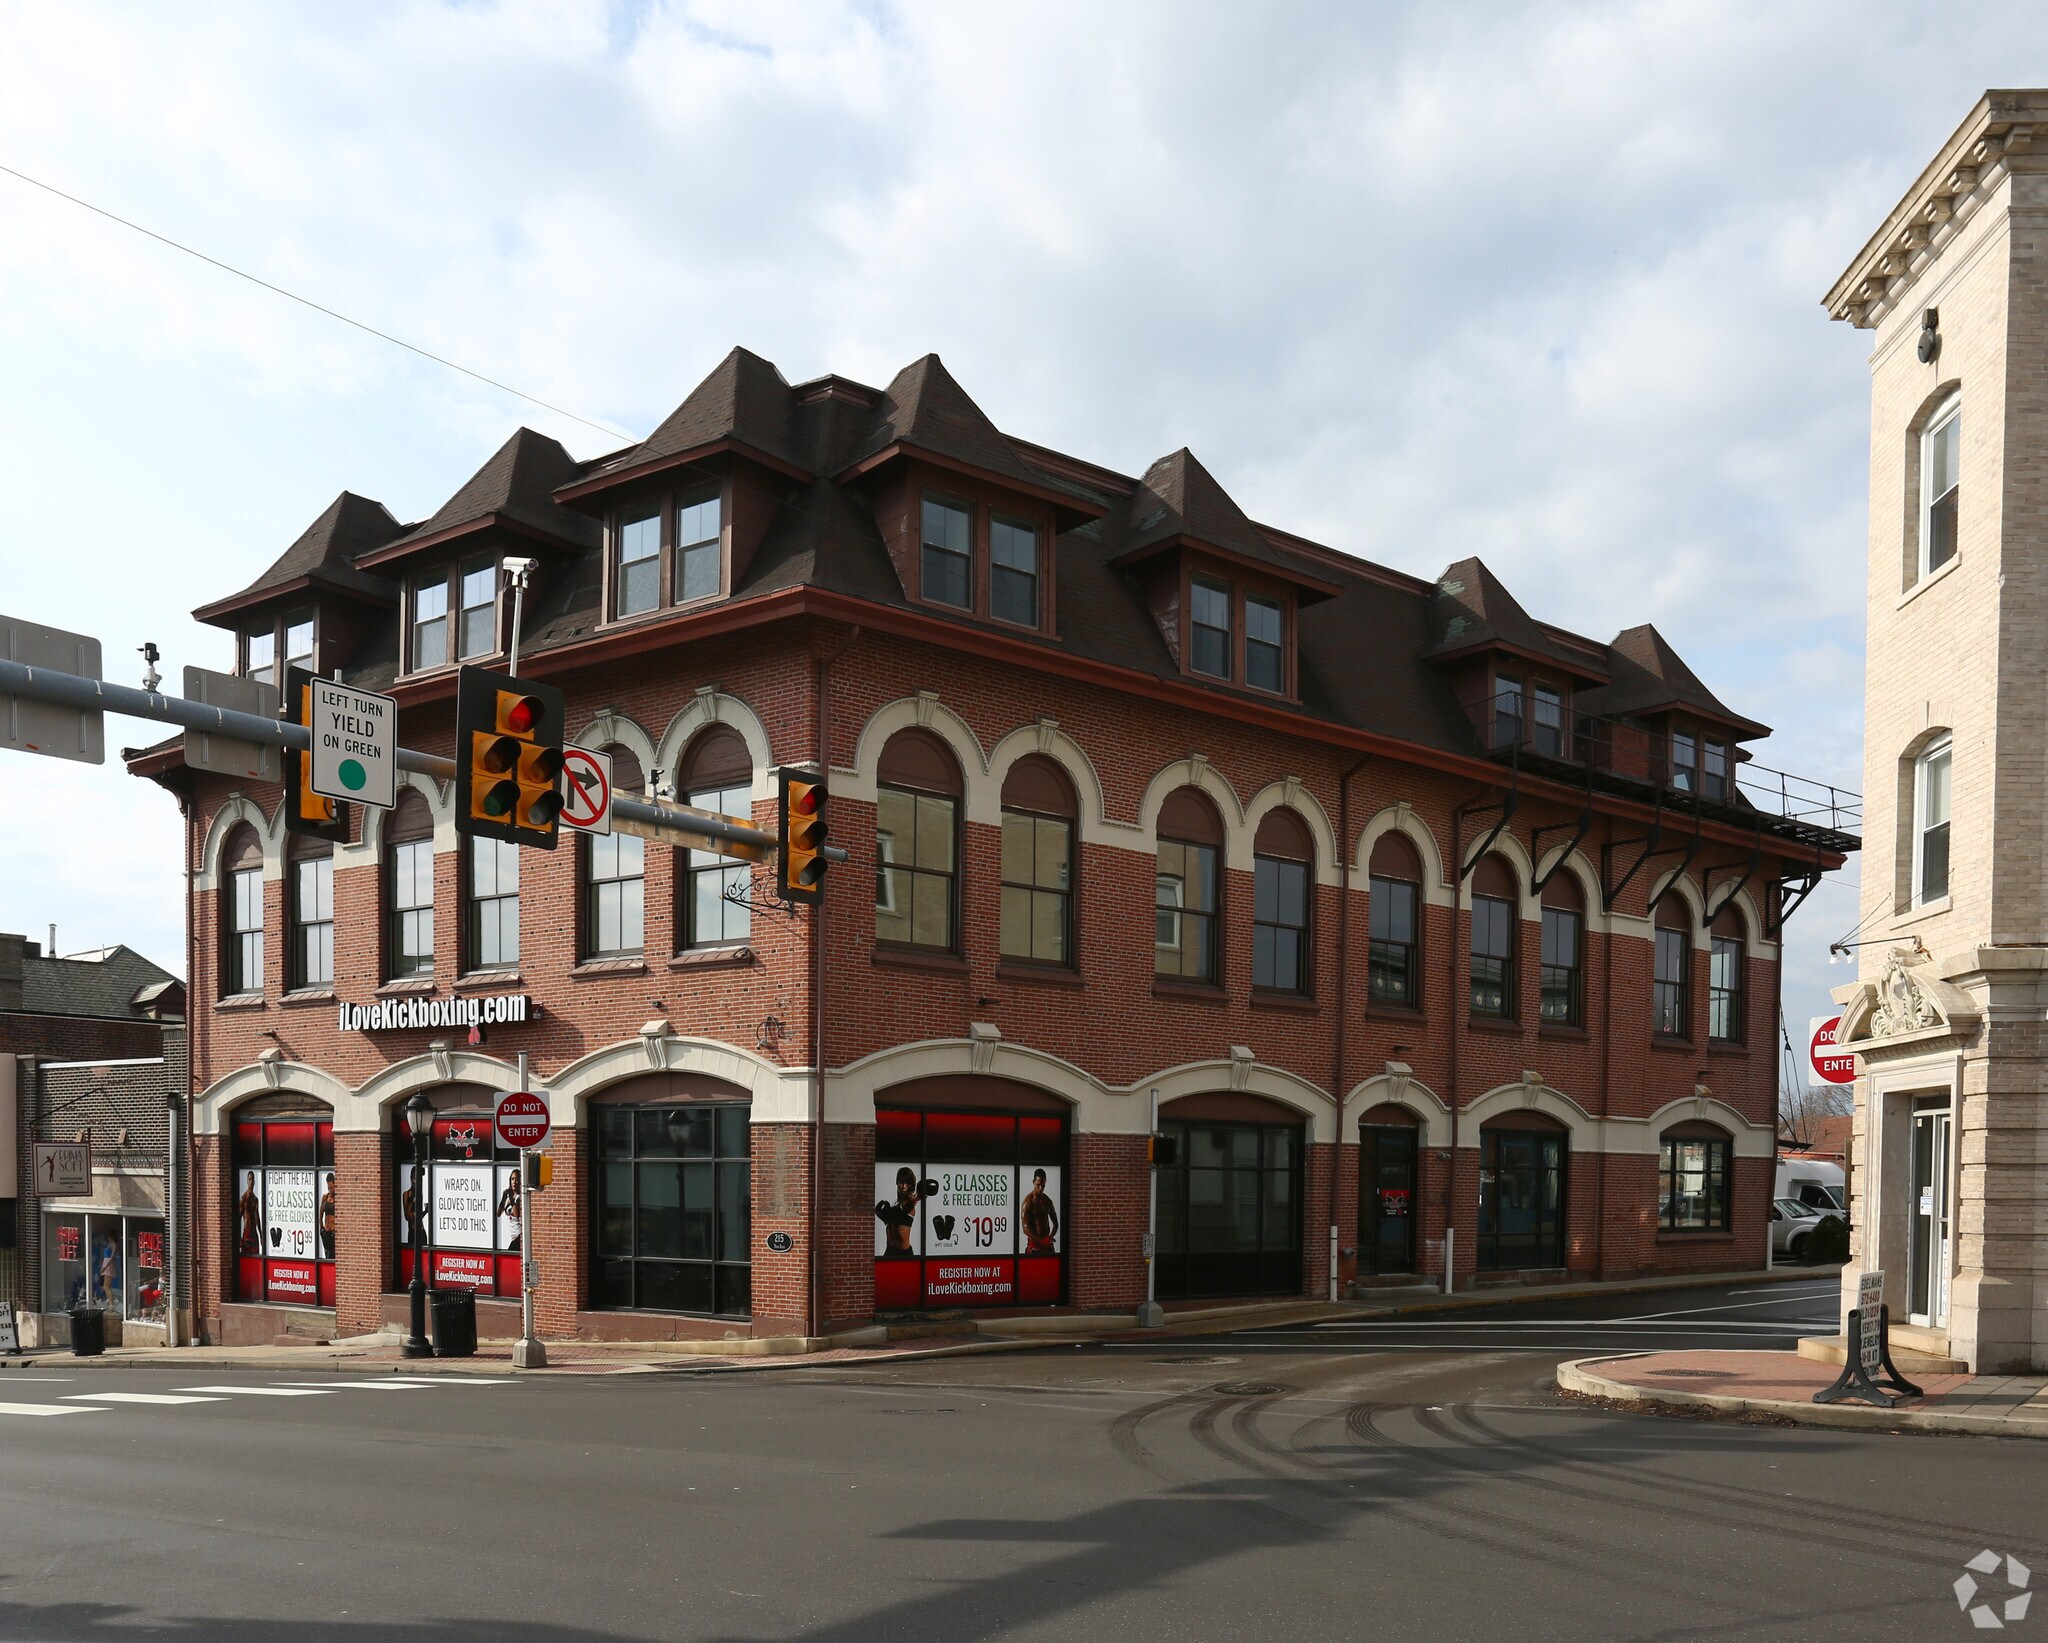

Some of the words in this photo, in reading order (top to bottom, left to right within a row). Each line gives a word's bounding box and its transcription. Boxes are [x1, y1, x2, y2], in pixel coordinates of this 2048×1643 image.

[322, 690, 349, 708] LEFT
[354, 698, 383, 717] TURN
[332, 712, 374, 738] YIELD
[323, 734, 339, 749] ON
[344, 739, 381, 759] GREEN
[339, 995, 526, 1031] iLoveKickboxing.com
[1823, 1059, 1853, 1071] ENTE
[503, 1103, 517, 1113] DO
[522, 1102, 542, 1112] NOT
[508, 1127, 539, 1137] ENTER
[59, 1160, 83, 1172] SOFT
[268, 1172, 286, 1185] FIGHT
[288, 1172, 300, 1186] THE
[301, 1172, 314, 1186] FAT!
[444, 1178, 469, 1191] WRAPS
[470, 1178, 483, 1192] ON.
[943, 1173, 951, 1191] 3
[954, 1174, 1008, 1192] CLASSES
[268, 1190, 274, 1207] 3
[276, 1190, 314, 1209] CLASSES
[438, 1197, 465, 1210] GLOVES
[466, 1198, 489, 1212] TIGHT.
[942, 1193, 950, 1206] &
[952, 1193, 972, 1206] FREE
[973, 1194, 1008, 1206] GLOVES!
[268, 1210, 273, 1221] &
[274, 1210, 288, 1222] FREE
[290, 1210, 314, 1223] GLOVES!
[439, 1217, 457, 1231] LET'S
[458, 1217, 469, 1231] DO
[470, 1218, 488, 1232] THIS.
[442, 1257, 465, 1268] REGISTER
[465, 1259, 479, 1269] NOW
[478, 1260, 485, 1270] AT
[273, 1268, 293, 1278] REGISTER
[292, 1270, 304, 1279] NOW
[303, 1270, 310, 1280] AT
[939, 1267, 973, 1279] REGISTER
[973, 1267, 991, 1278] NOW
[992, 1266, 1001, 1277] AT
[928, 1281, 1012, 1295] iLoveKickboxing.com
